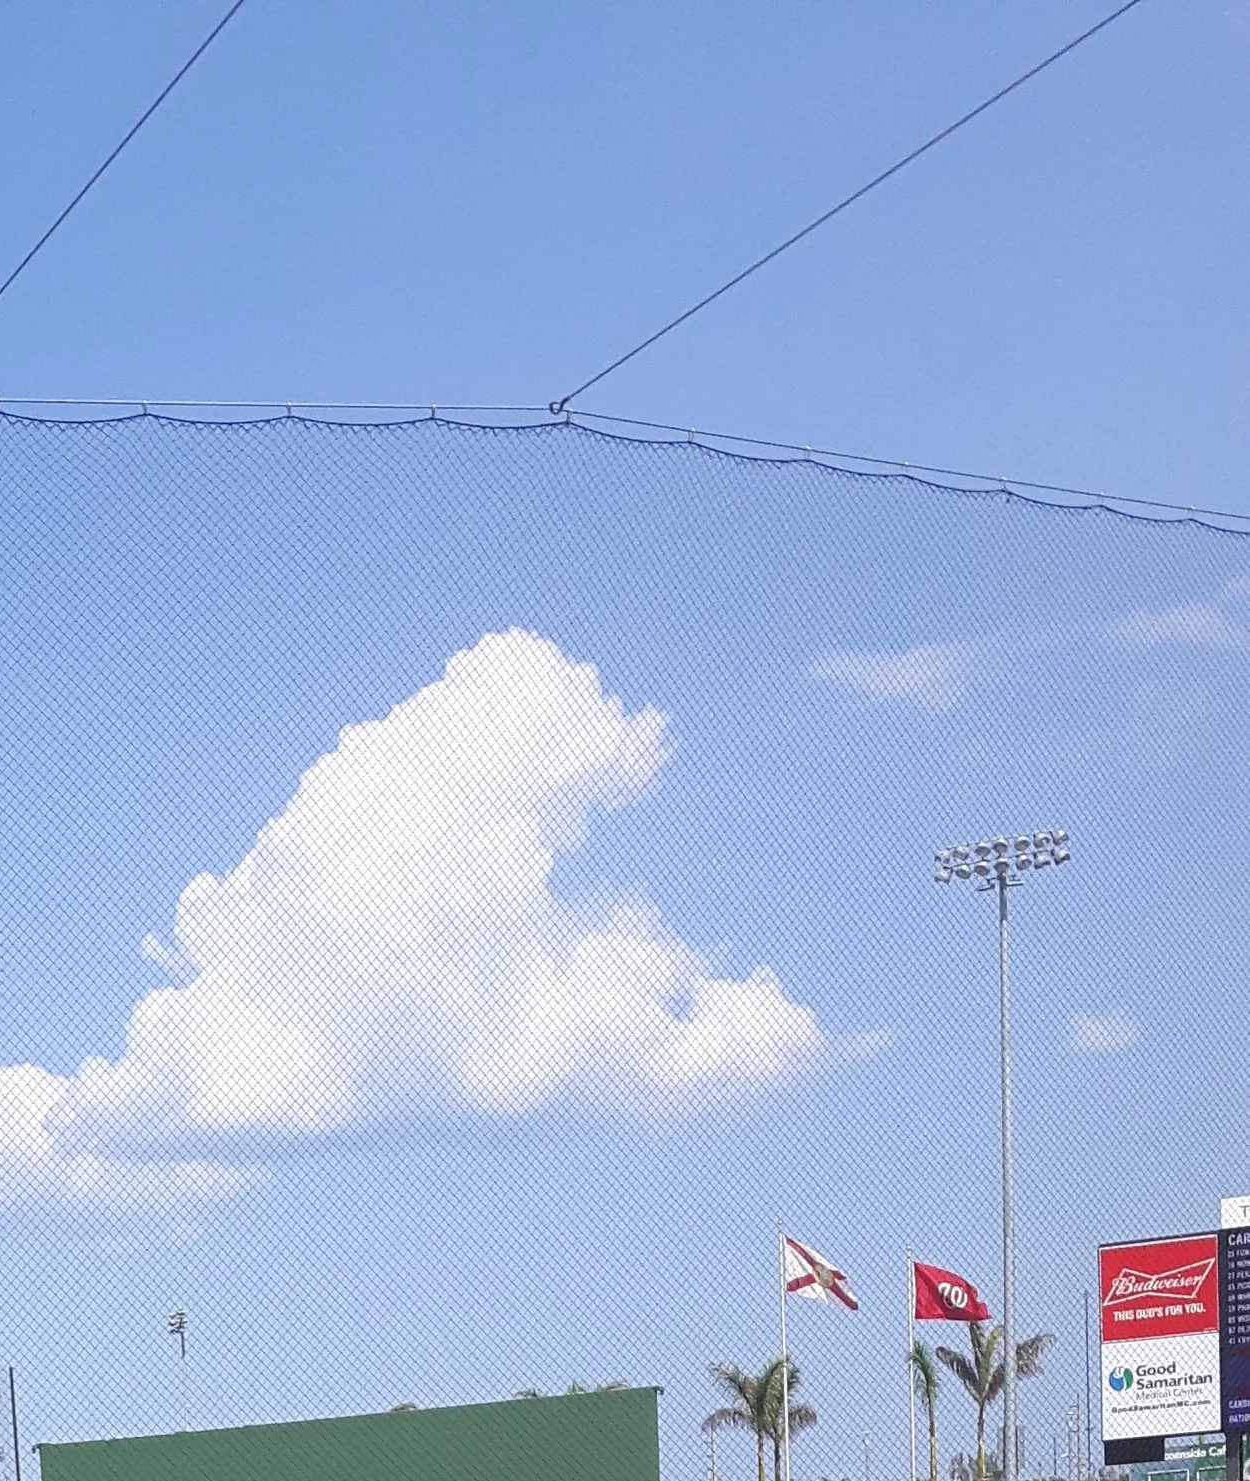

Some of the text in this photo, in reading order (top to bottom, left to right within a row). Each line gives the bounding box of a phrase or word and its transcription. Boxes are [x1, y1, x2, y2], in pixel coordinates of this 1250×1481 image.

[1111, 1273, 1204, 1296] Budweiser
[1113, 1310, 1135, 1321] THIS
[1165, 1305, 1183, 1316] FOR
[1136, 1361, 1177, 1376] Good
[1136, 1373, 1213, 1390] Samaritan
[1136, 1388, 1203, 1401] Medical Center
